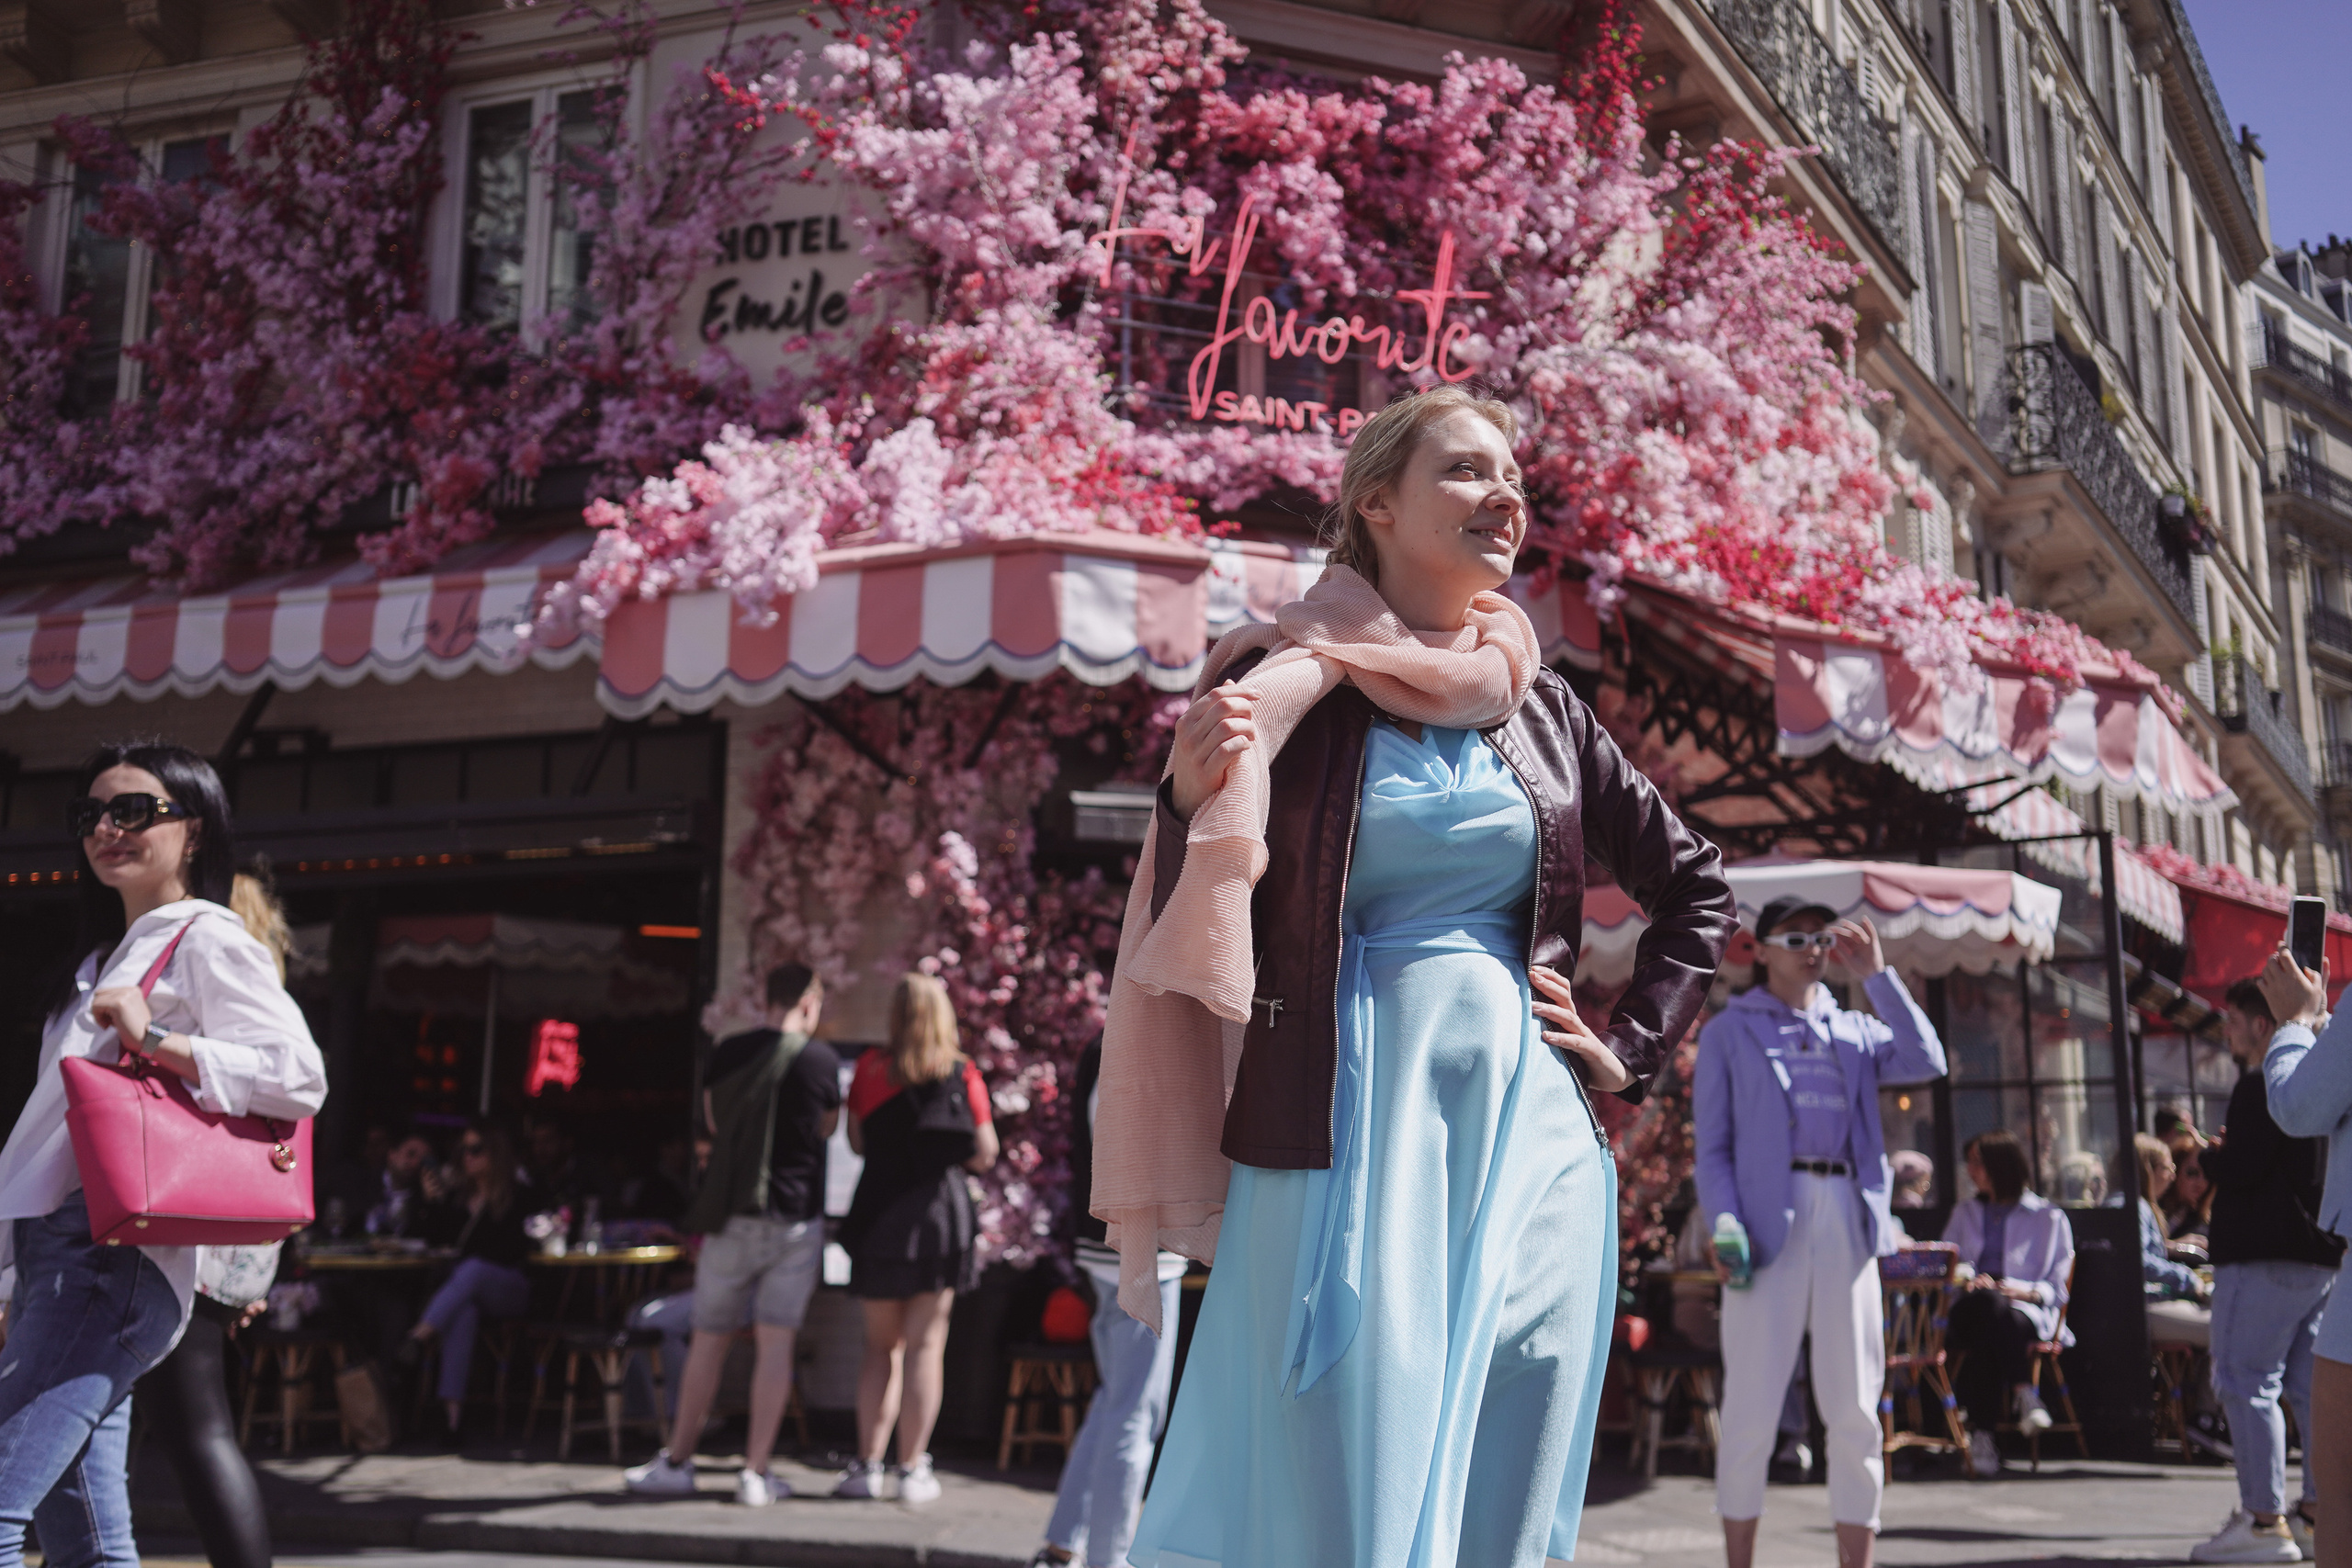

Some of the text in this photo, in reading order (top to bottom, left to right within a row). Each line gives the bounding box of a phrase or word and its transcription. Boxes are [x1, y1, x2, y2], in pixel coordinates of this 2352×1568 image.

[714, 214, 850, 265] HOTEL
[700, 268, 849, 344] Emile
[1214, 390, 1379, 436] SAINT-P
